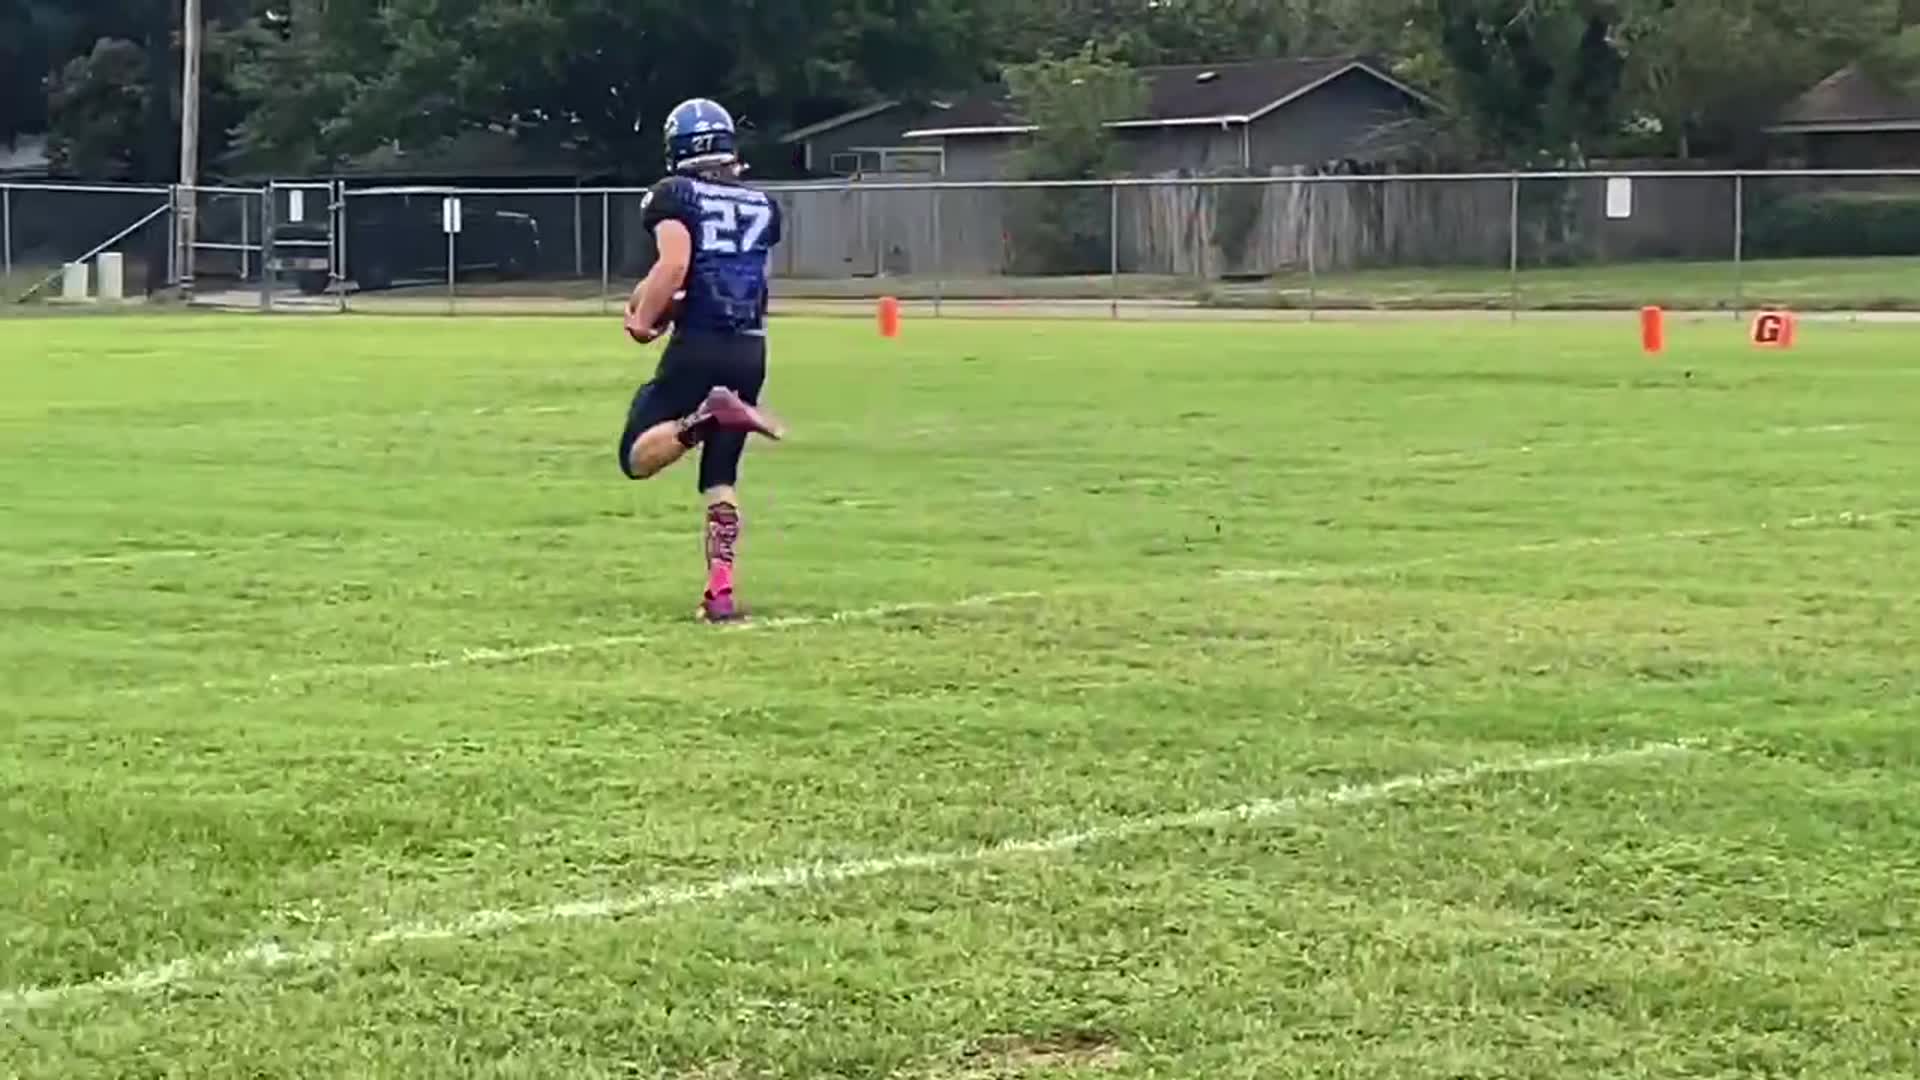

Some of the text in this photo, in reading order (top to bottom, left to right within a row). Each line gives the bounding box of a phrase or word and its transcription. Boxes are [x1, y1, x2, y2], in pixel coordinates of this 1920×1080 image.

[692, 134, 714, 151] 27
[700, 200, 770, 252] 27
[1755, 315, 1780, 342] G
